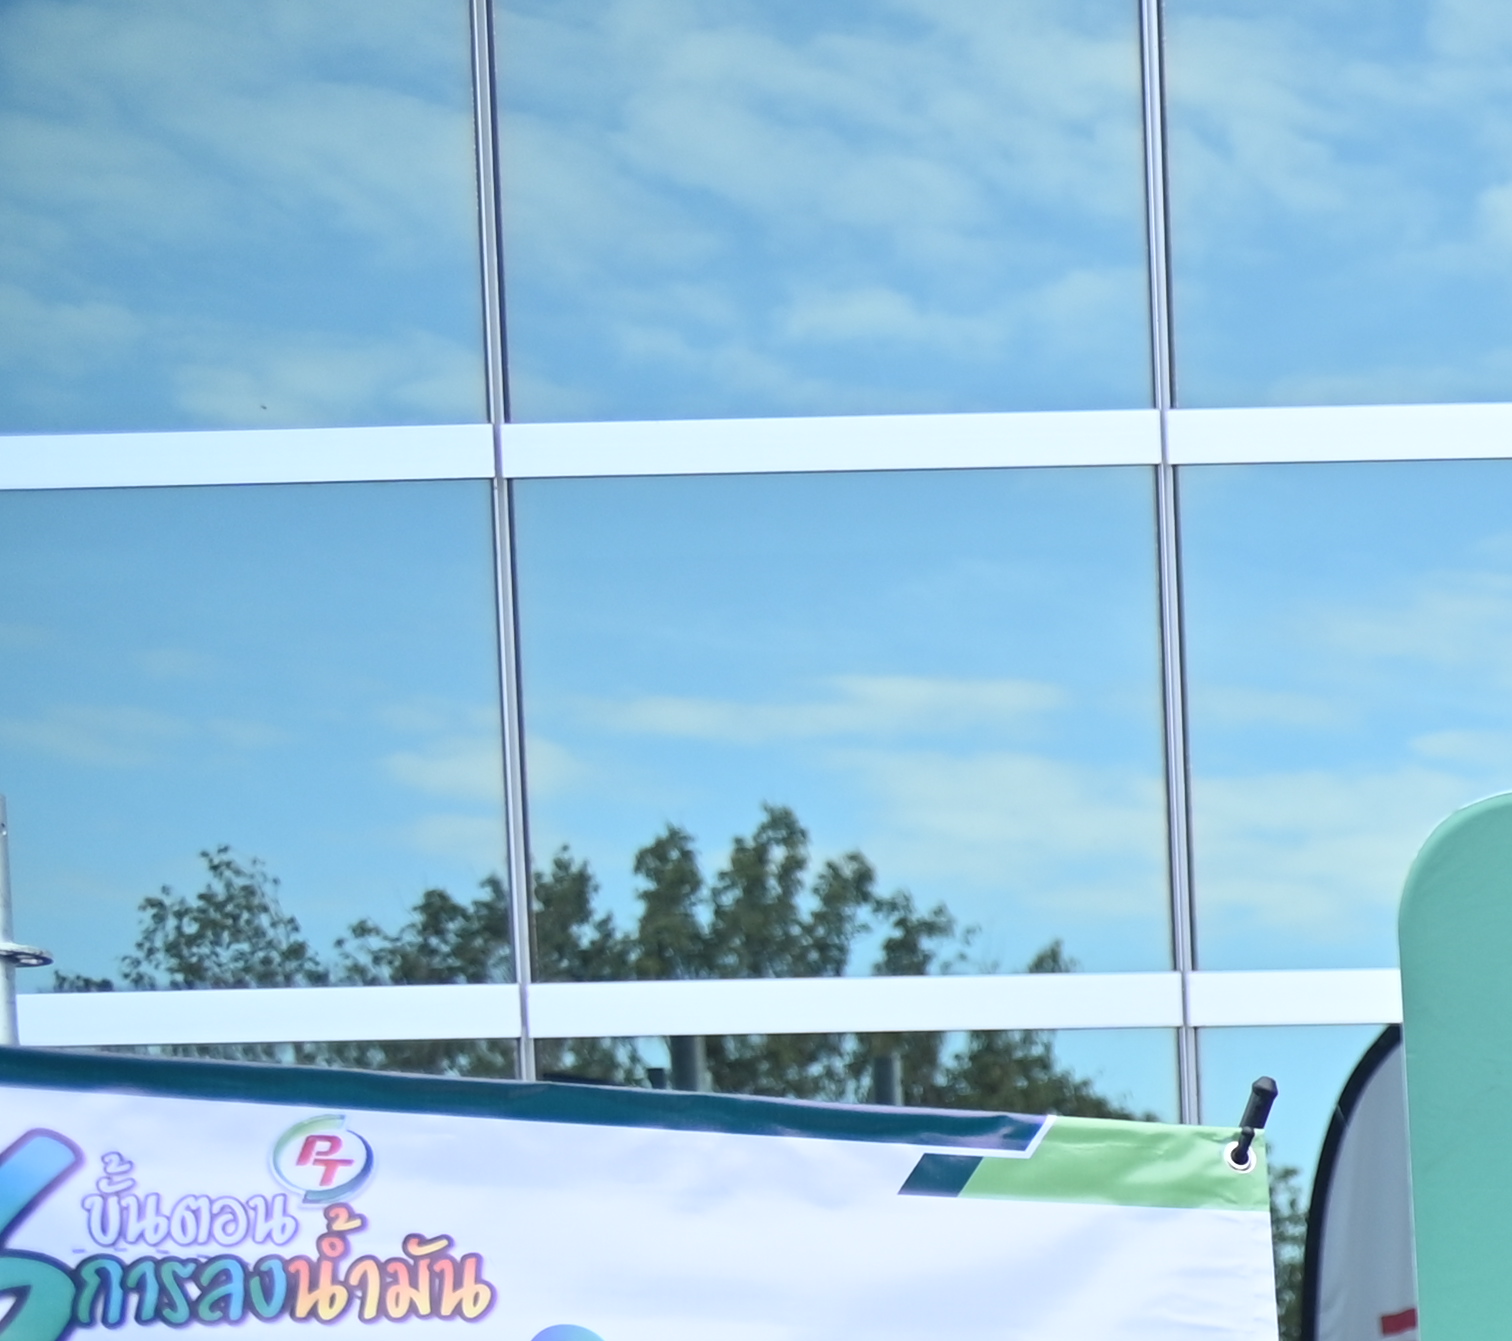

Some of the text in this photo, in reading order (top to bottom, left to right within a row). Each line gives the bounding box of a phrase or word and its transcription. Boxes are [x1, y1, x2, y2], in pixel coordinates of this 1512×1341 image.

[81, 1151, 298, 1249] ขั้นตอน
[295, 1133, 354, 1187] PT
[73, 1203, 498, 1329] การลงน้ำมัน
